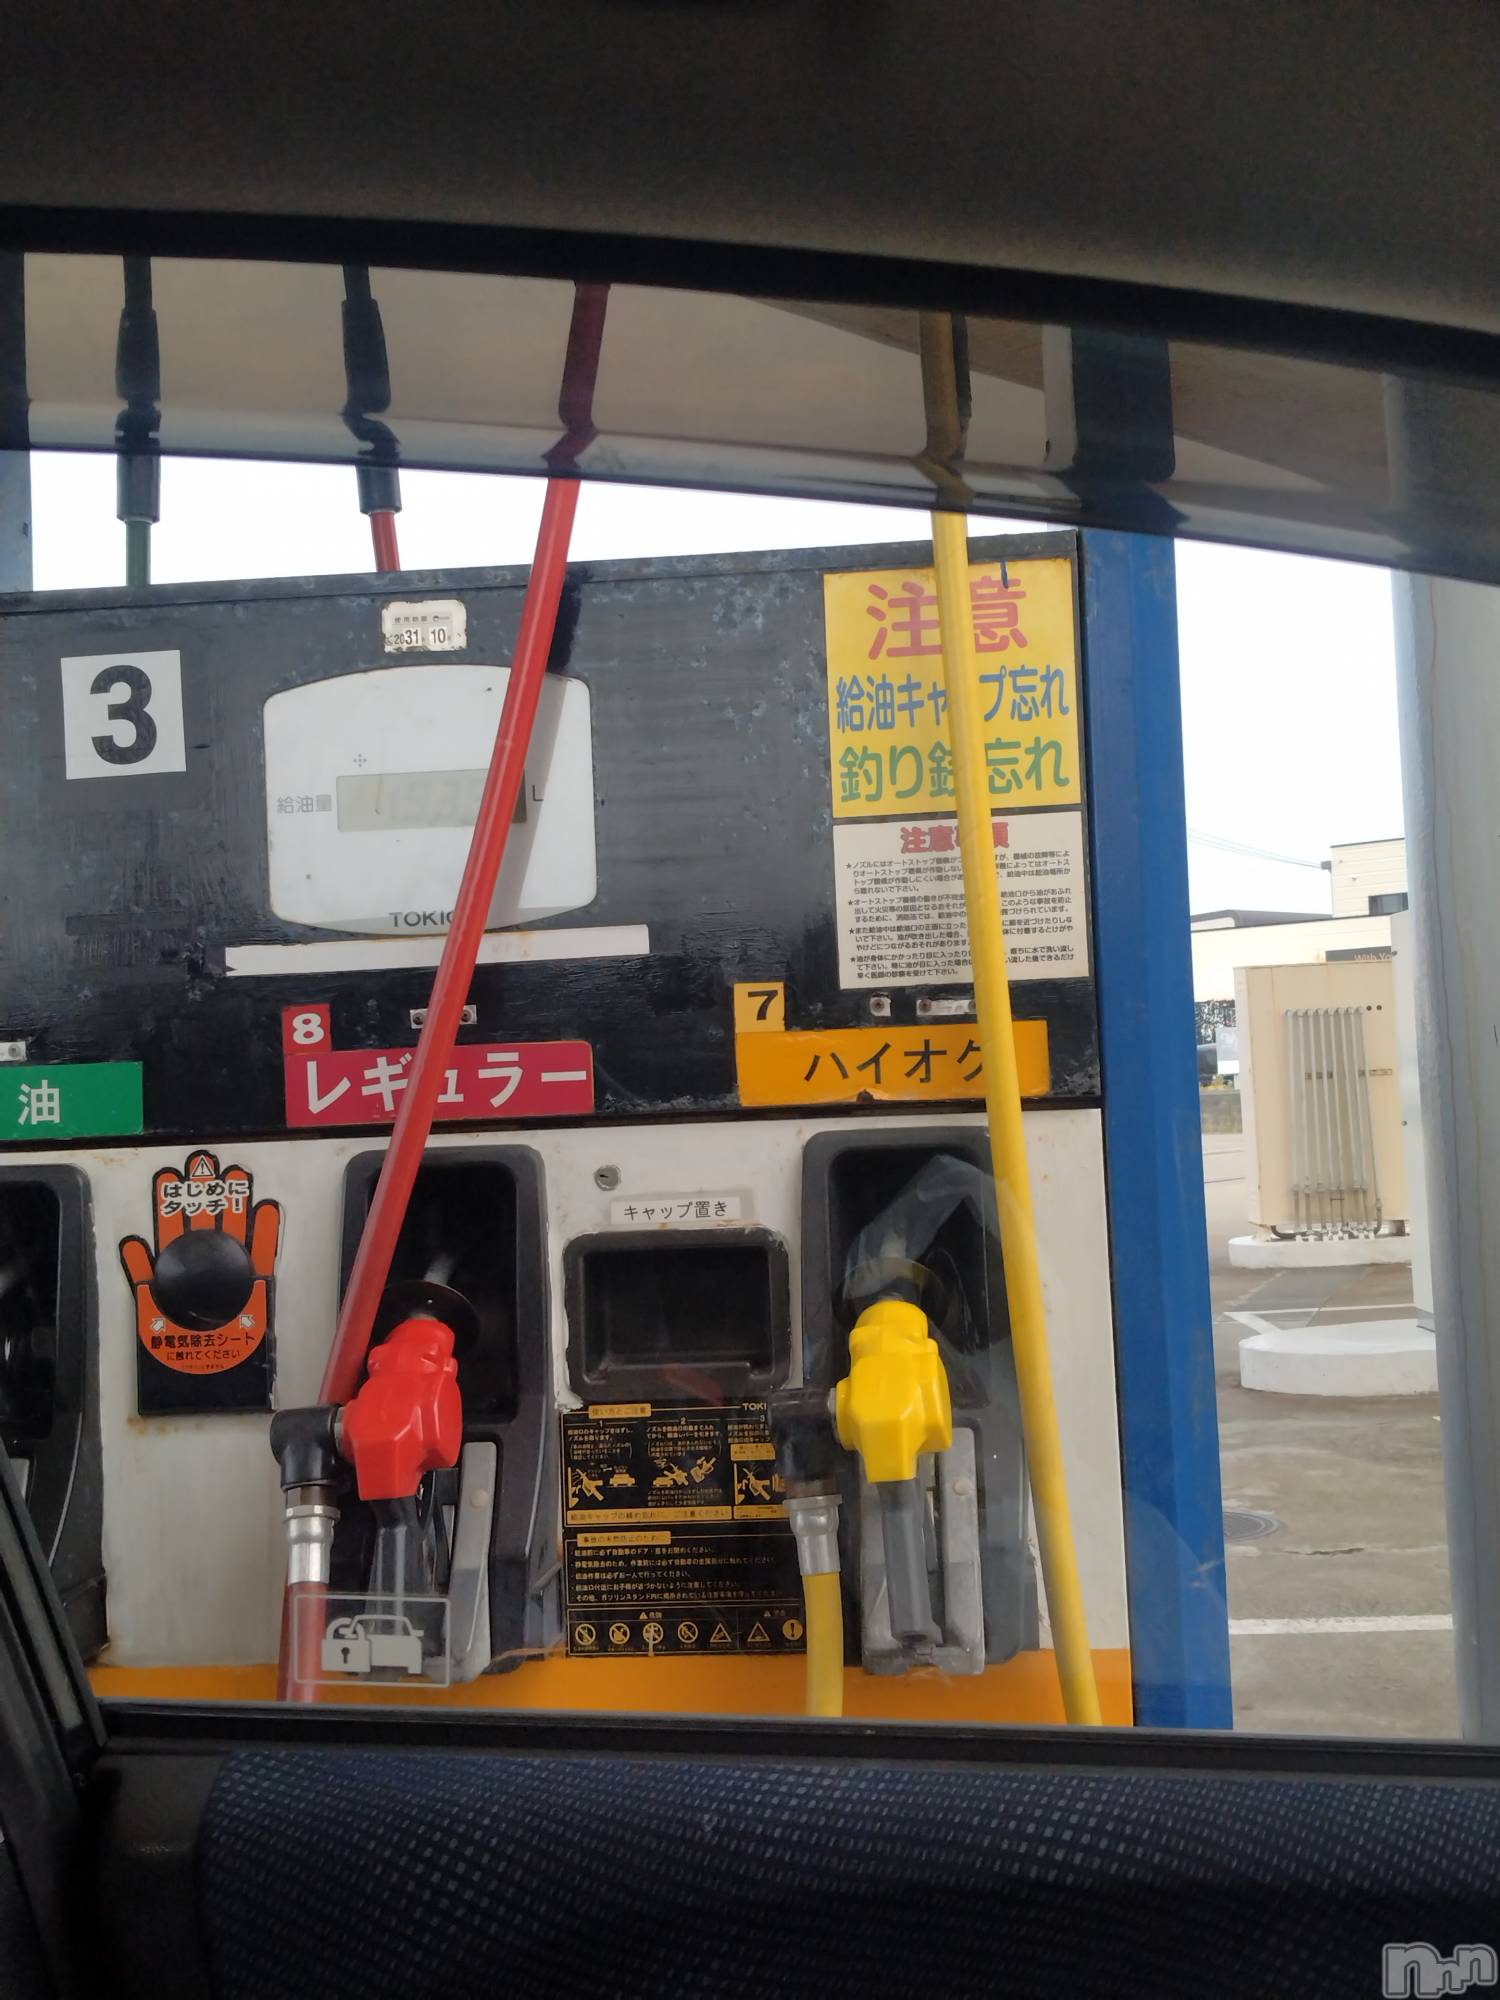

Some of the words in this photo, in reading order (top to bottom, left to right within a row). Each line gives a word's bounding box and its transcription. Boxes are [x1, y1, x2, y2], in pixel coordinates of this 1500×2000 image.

[89, 664, 159, 766] 3
[835, 664, 1070, 734] 給油キャプ忘れ
[276, 794, 333, 814] 給油量
[747, 989, 779, 1021] 7
[291, 1012, 325, 1045] 8
[304, 1050, 588, 1115] レギュラー
[162, 1182, 249, 1199] はじめに
[623, 1201, 728, 1221] キャップ置き
